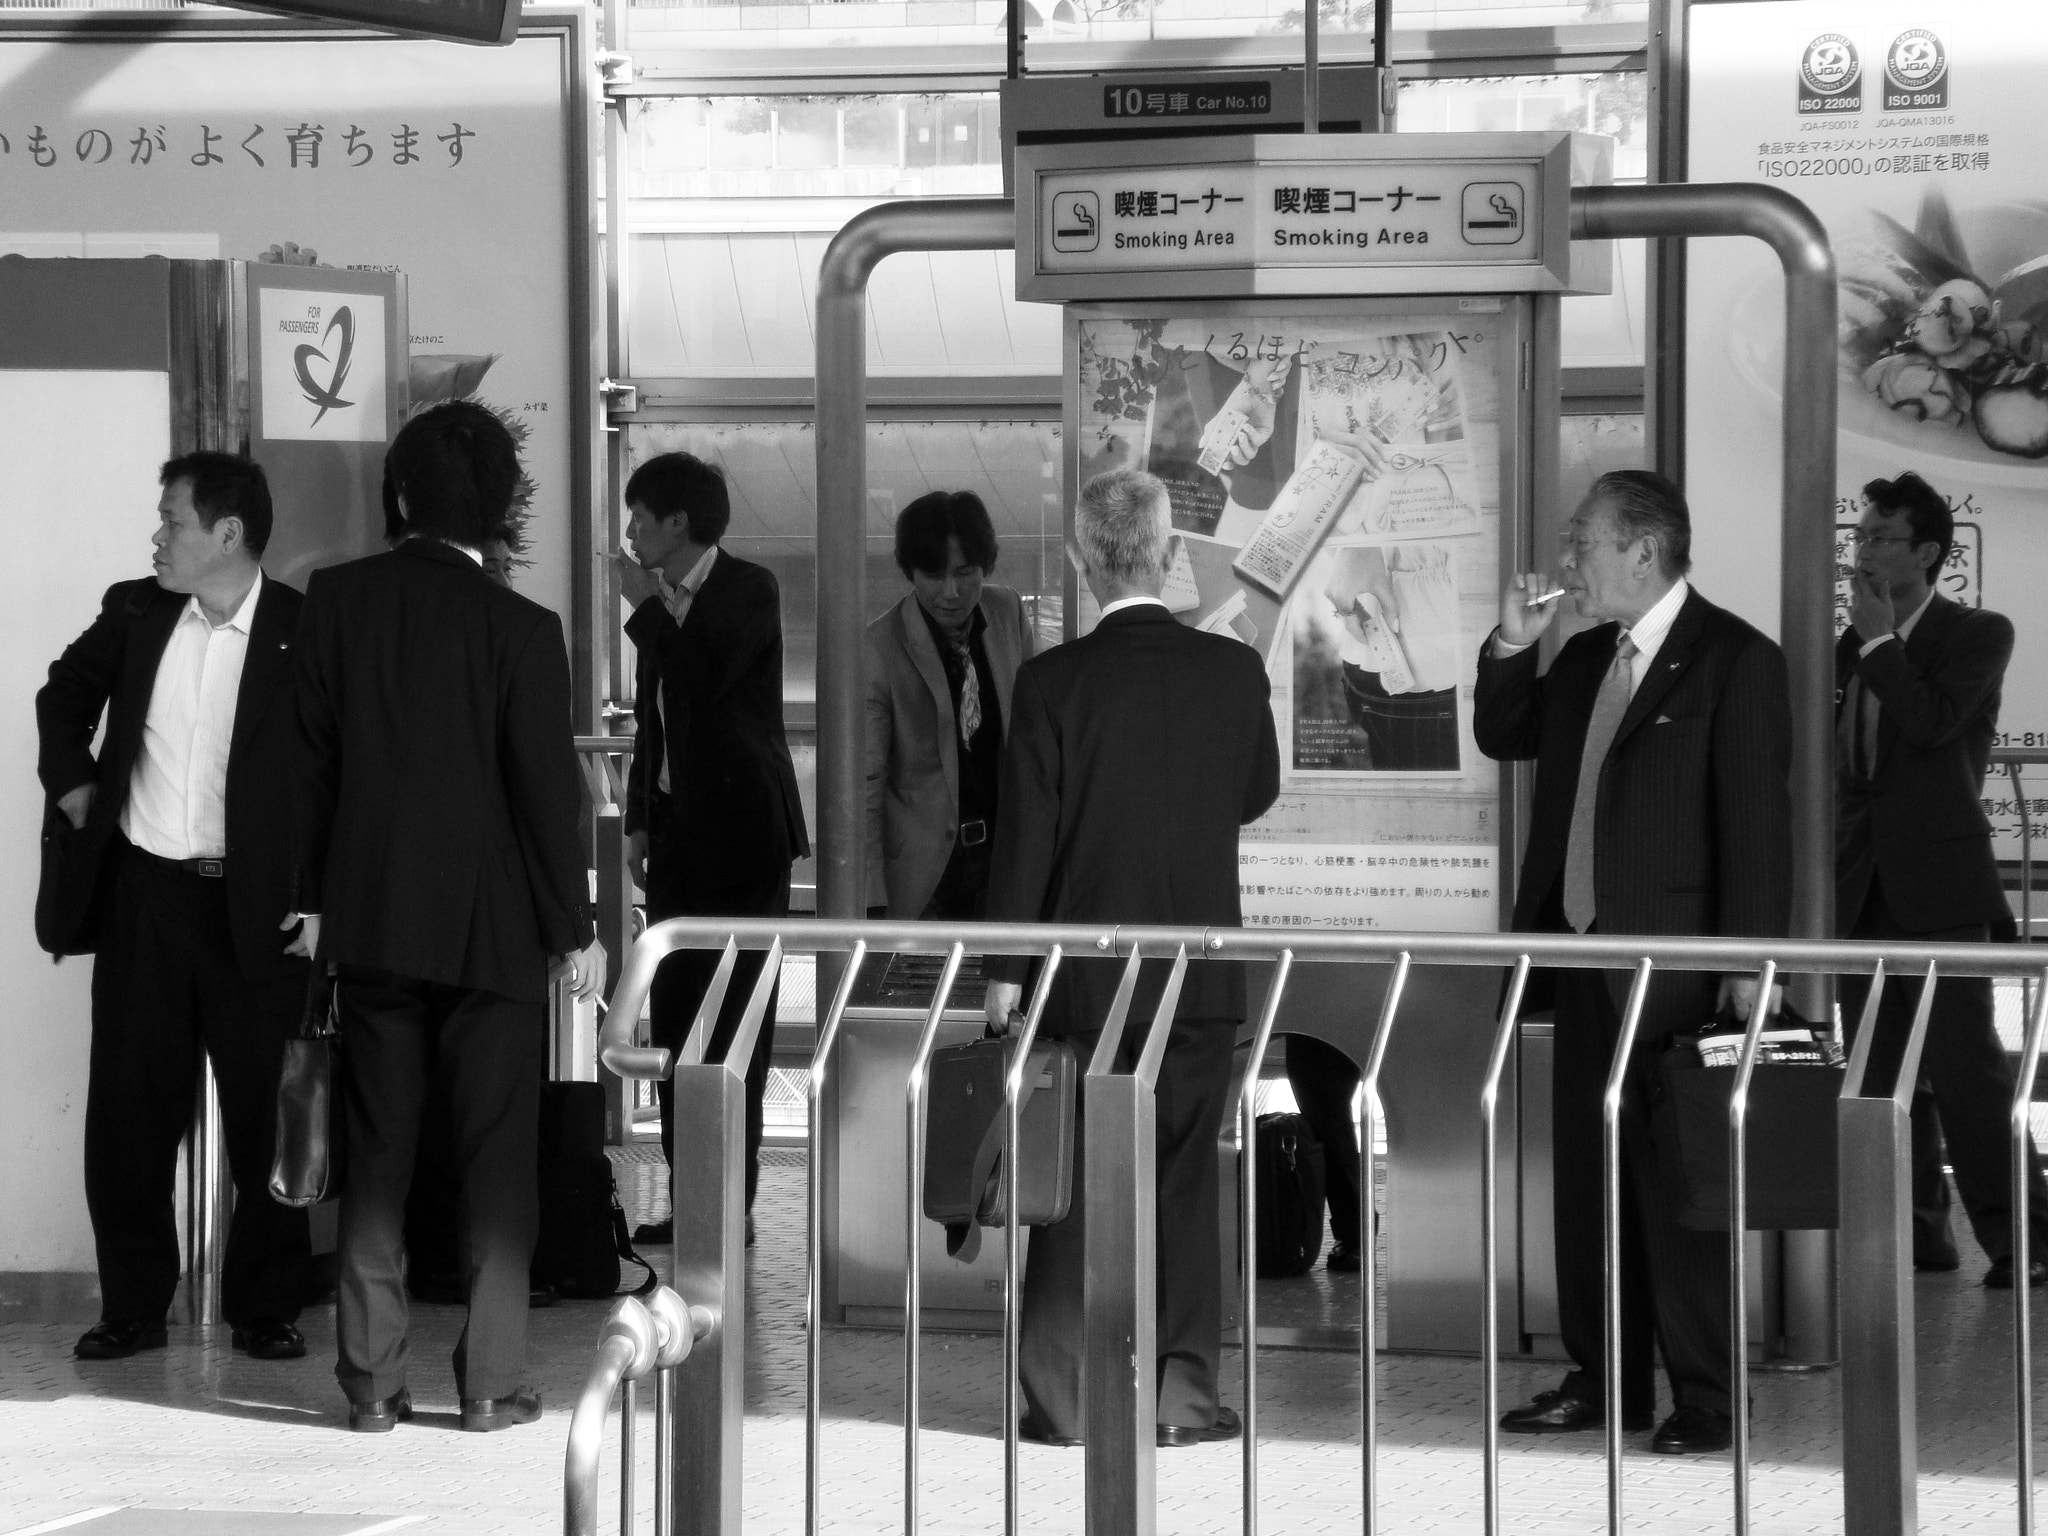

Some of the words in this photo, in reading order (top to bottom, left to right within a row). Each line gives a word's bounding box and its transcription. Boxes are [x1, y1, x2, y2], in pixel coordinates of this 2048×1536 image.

[1810, 34, 1850, 49] CERTIFIED
[1896, 29, 1937, 45] CERTIFIED
[1816, 67, 1844, 76] JQA
[1901, 62, 1931, 71] JQA
[1110, 89, 1190, 114] 10号車
[1197, 97, 1220, 110] Car
[1226, 95, 1267, 109] No.10
[1800, 99, 1821, 110] ISO
[1825, 98, 1860, 109] 22000
[1889, 95, 1910, 106] ISO
[1914, 94, 1941, 105] 9001
[1800, 120, 1859, 131] JQA-FS0012
[1758, 134, 1989, 155] 食品安全マネジメントシステムの国際規格
[1758, 152, 1990, 178] 「ISO22000」の認証を取得
[1115, 188, 1244, 217] 喫煙コーナー
[1274, 186, 1441, 214] 喫煙コーナー
[1115, 231, 1188, 249] Smoking
[1194, 230, 1235, 246] Area
[1274, 229, 1369, 248] Smoking
[1377, 228, 1429, 244] Area
[308, 306, 321, 318] FOR
[279, 320, 320, 334] PASSENGERS
